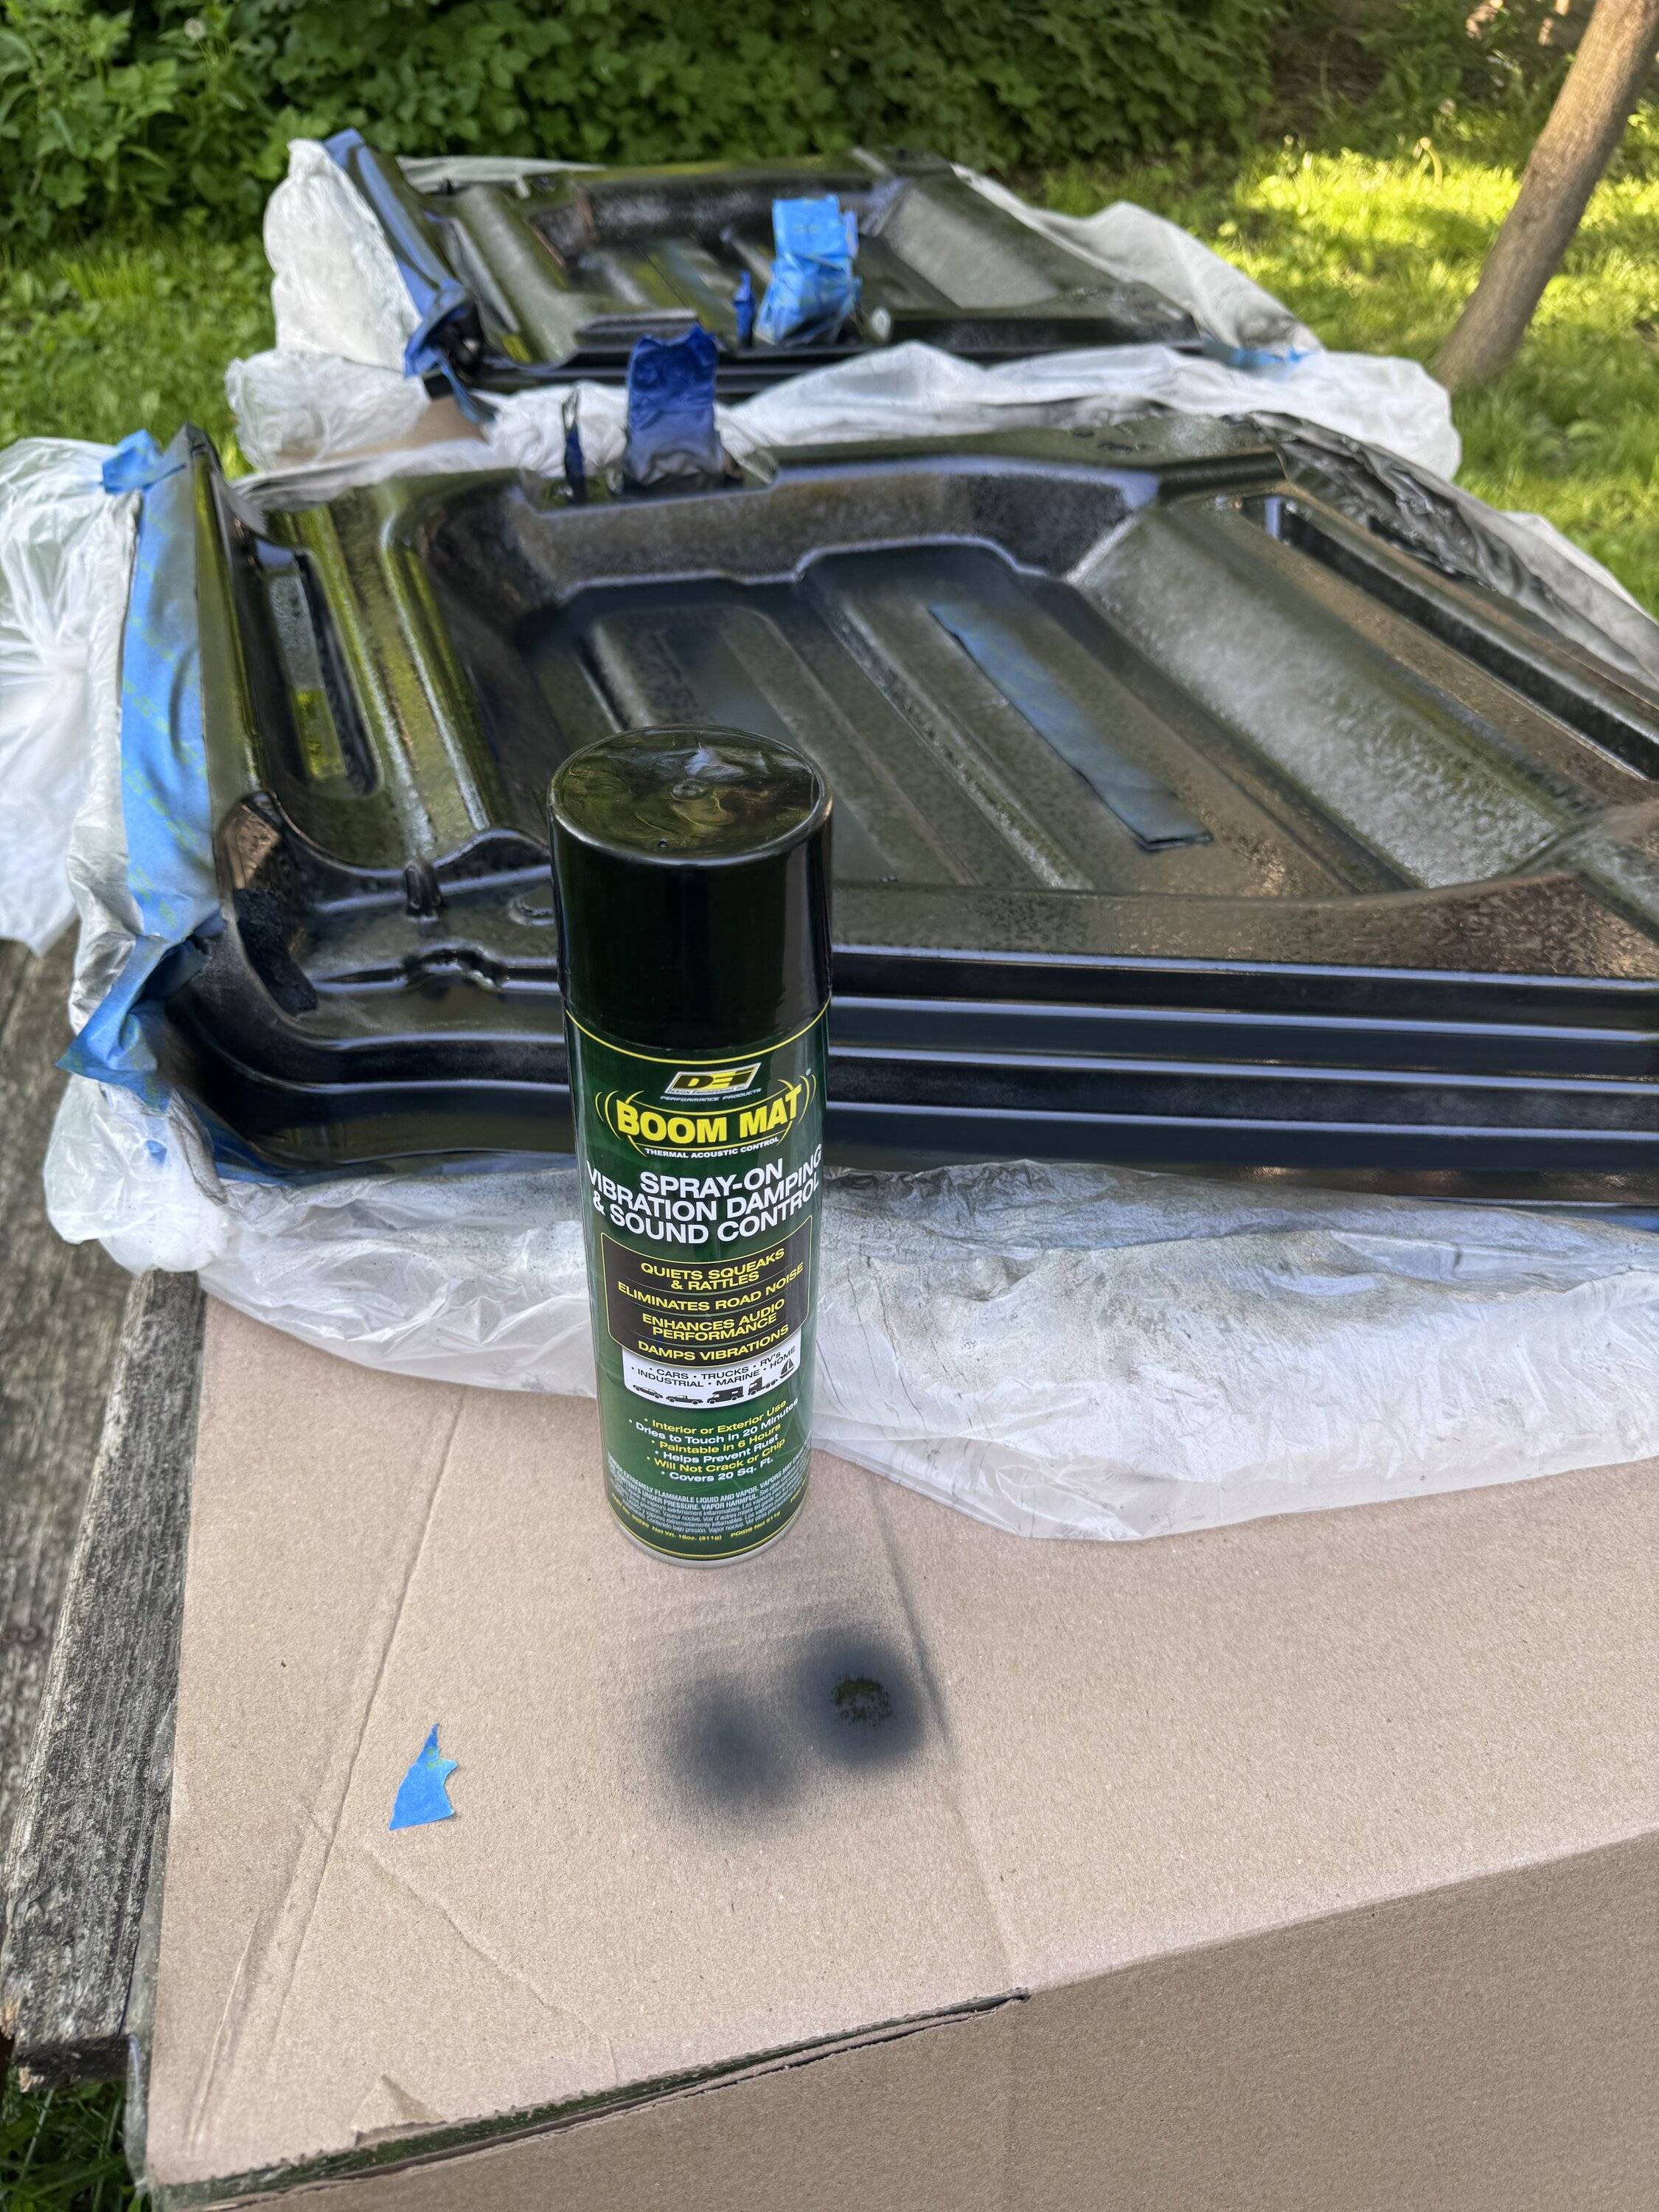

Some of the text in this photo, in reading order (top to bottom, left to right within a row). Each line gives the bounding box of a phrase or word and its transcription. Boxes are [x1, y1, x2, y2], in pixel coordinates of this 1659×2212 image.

[616, 1083, 801, 1144] BOOM MAT
[644, 1136, 779, 1158] THERMAL ACOUSTIC CONTROL
[586, 1144, 822, 1222] VIBRATION DAMPING
[639, 1158, 783, 1199] SPRAY-ON
[592, 1171, 819, 1245] & SOUND CONTROL
[640, 1248, 785, 1280] QUIETS SQUEAKS
[670, 1271, 760, 1291] & RATTLES
[617, 1261, 804, 1312] ELIMINATES ROAD NOISE
[641, 1298, 785, 1332] ENHANCES AUDIO
[652, 1312, 778, 1342] PERFORMANCE
[637, 1324, 790, 1362] DAMPS VIBRATIONS
[637, 1345, 797, 1388] INDUSTRIAL MARINE HOME
[655, 1368, 689, 1380] CARS
[700, 1366, 749, 1380] TRUCKS
[636, 1422, 666, 1439] Dries
[669, 1434, 683, 1444] to
[684, 1434, 724, 1444] Touch
[742, 1426, 759, 1438] 20
[759, 1397, 799, 1430] Minutes
[652, 1399, 787, 1435] Interior or Exterior Use
[658, 1441, 720, 1454] Paintable
[737, 1439, 746, 1449] 6
[748, 1422, 782, 1445] Hours
[663, 1433, 779, 1464] Helps Prevent Rust
[653, 1438, 786, 1473] Will Not Crack or Chip
[669, 1457, 773, 1483] Covers 20 Sq. Ft.
[622, 1470, 654, 1493] EXTREMELY
[654, 1489, 695, 1503] FLAMMABLE
[695, 1495, 720, 1503] LIQUID
[720, 1493, 736, 1503] AND
[759, 1470, 782, 1489] VAPORS
[641, 1489, 664, 1505] UNDER
[701, 1502, 726, 1511] VAPOR
